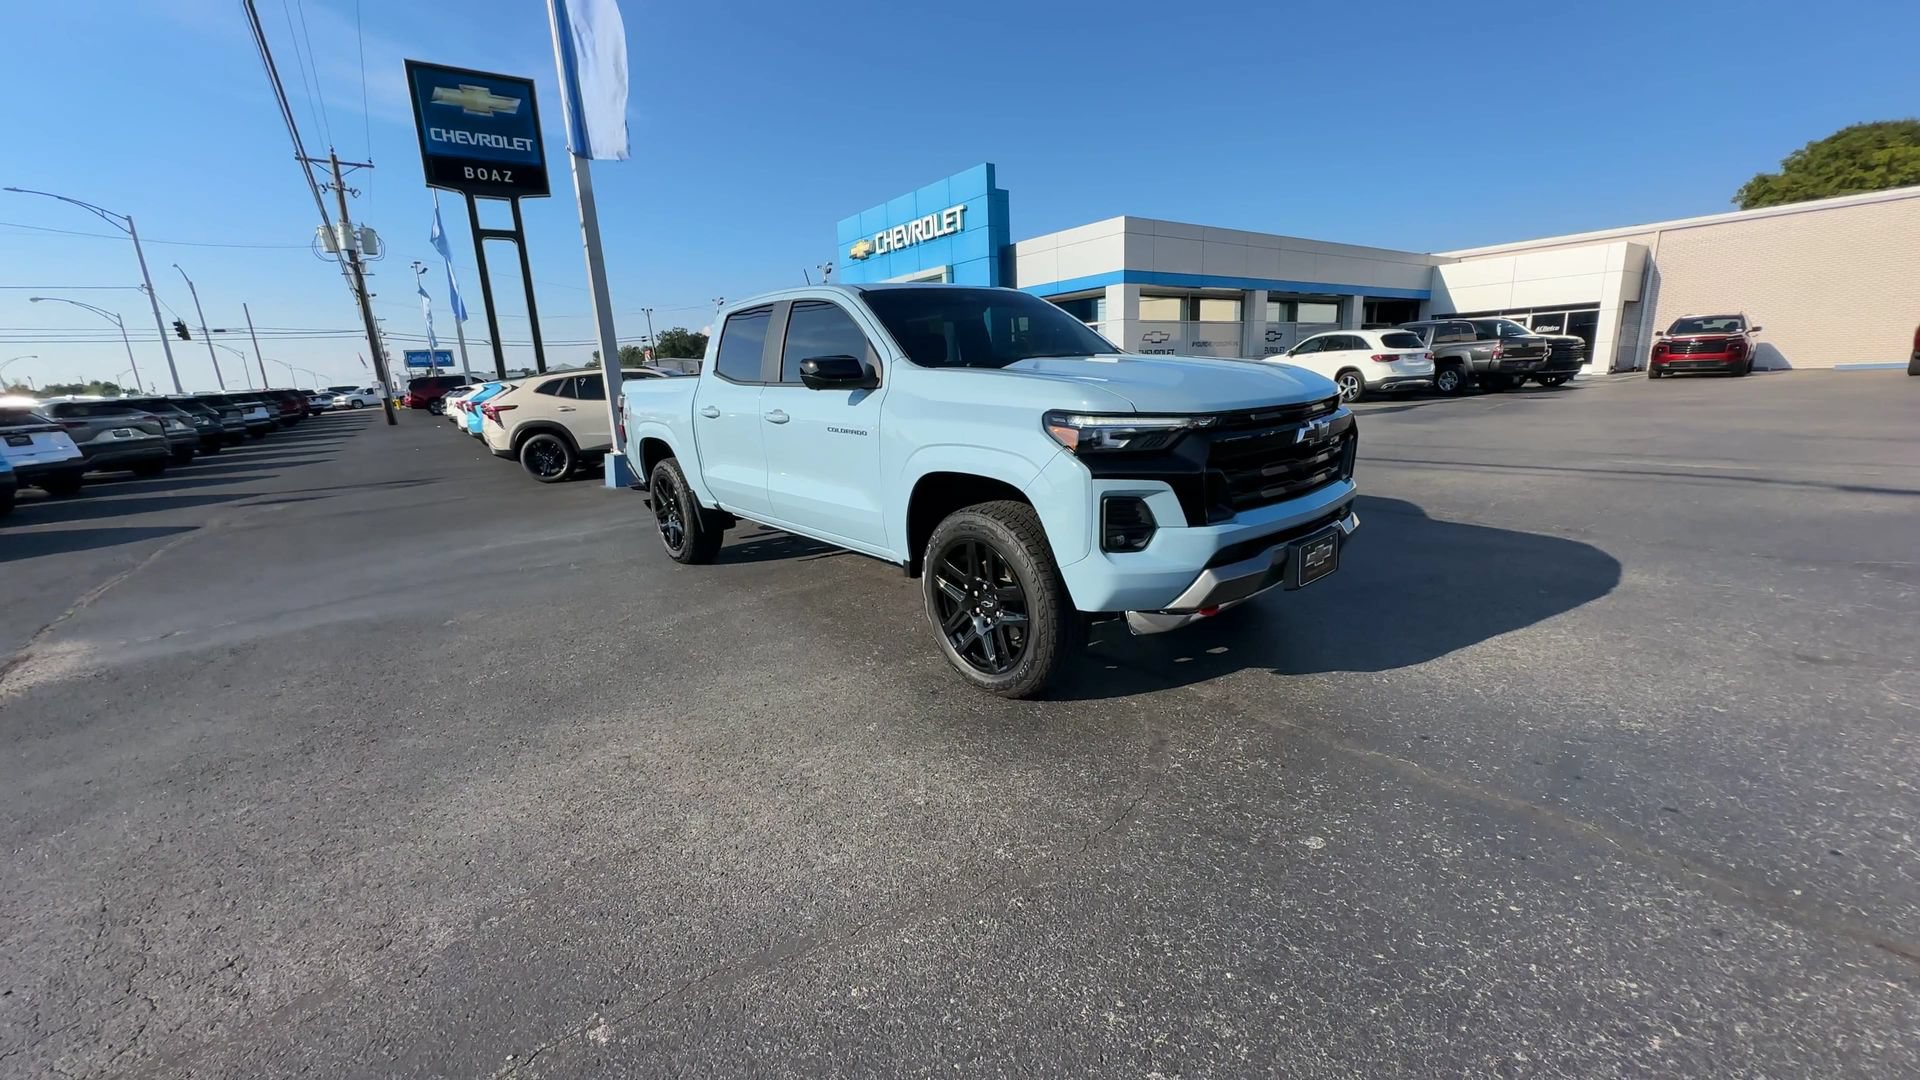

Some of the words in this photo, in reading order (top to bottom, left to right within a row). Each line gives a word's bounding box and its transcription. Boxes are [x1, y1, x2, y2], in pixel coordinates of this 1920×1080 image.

[430, 127, 533, 152] CHEVROLET
[463, 166, 514, 183] BOAZ
[875, 204, 967, 255] CHEVROLET
[827, 426, 868, 436] COLORADO
